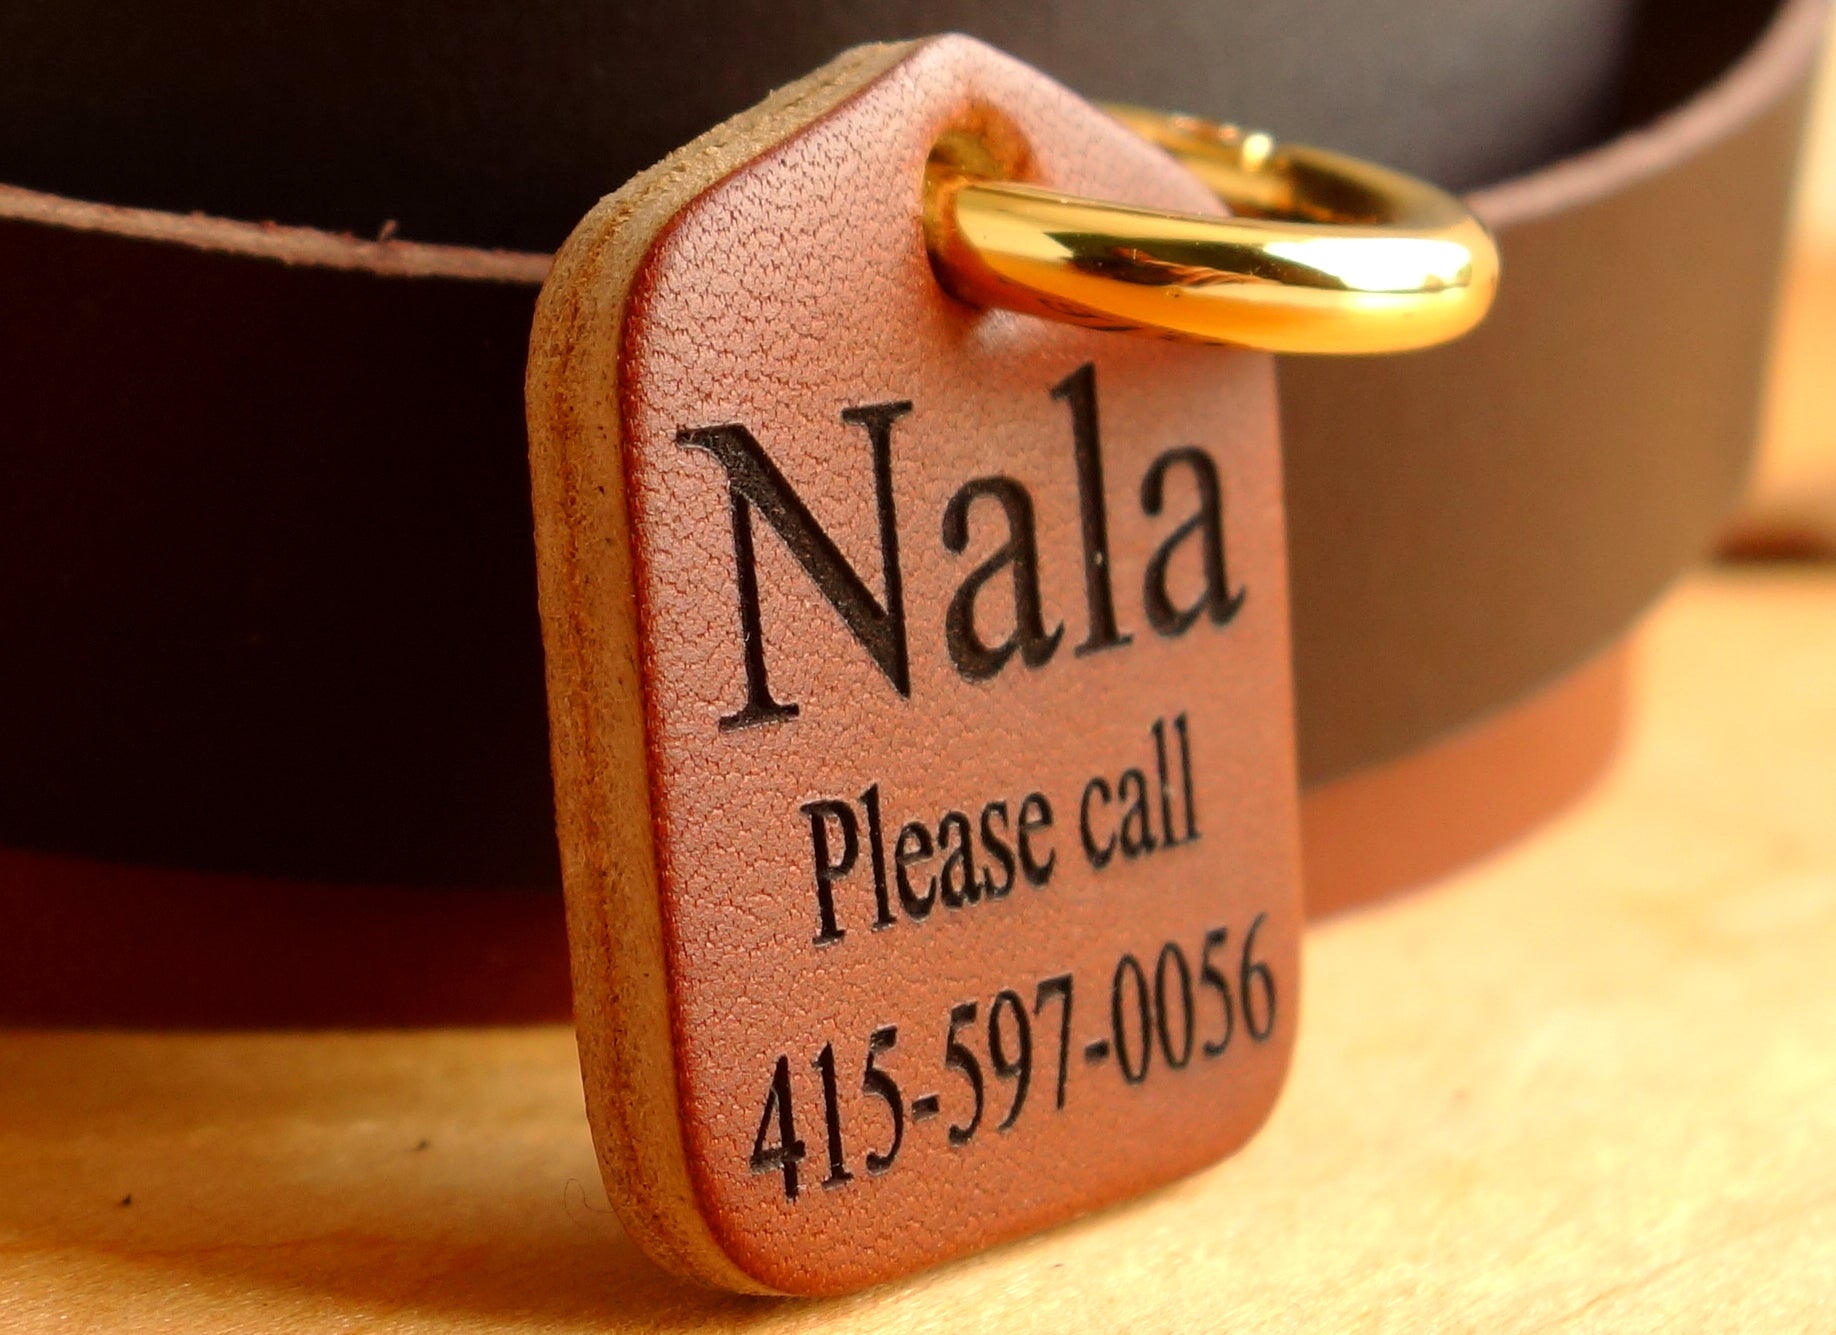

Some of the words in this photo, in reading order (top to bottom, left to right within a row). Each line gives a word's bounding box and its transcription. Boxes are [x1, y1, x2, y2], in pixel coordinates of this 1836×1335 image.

[677, 362, 1246, 731] Nala
[801, 784, 1056, 946] Please
[1081, 713, 1201, 868] call
[750, 913, 1277, 1201] 415-597-0056
